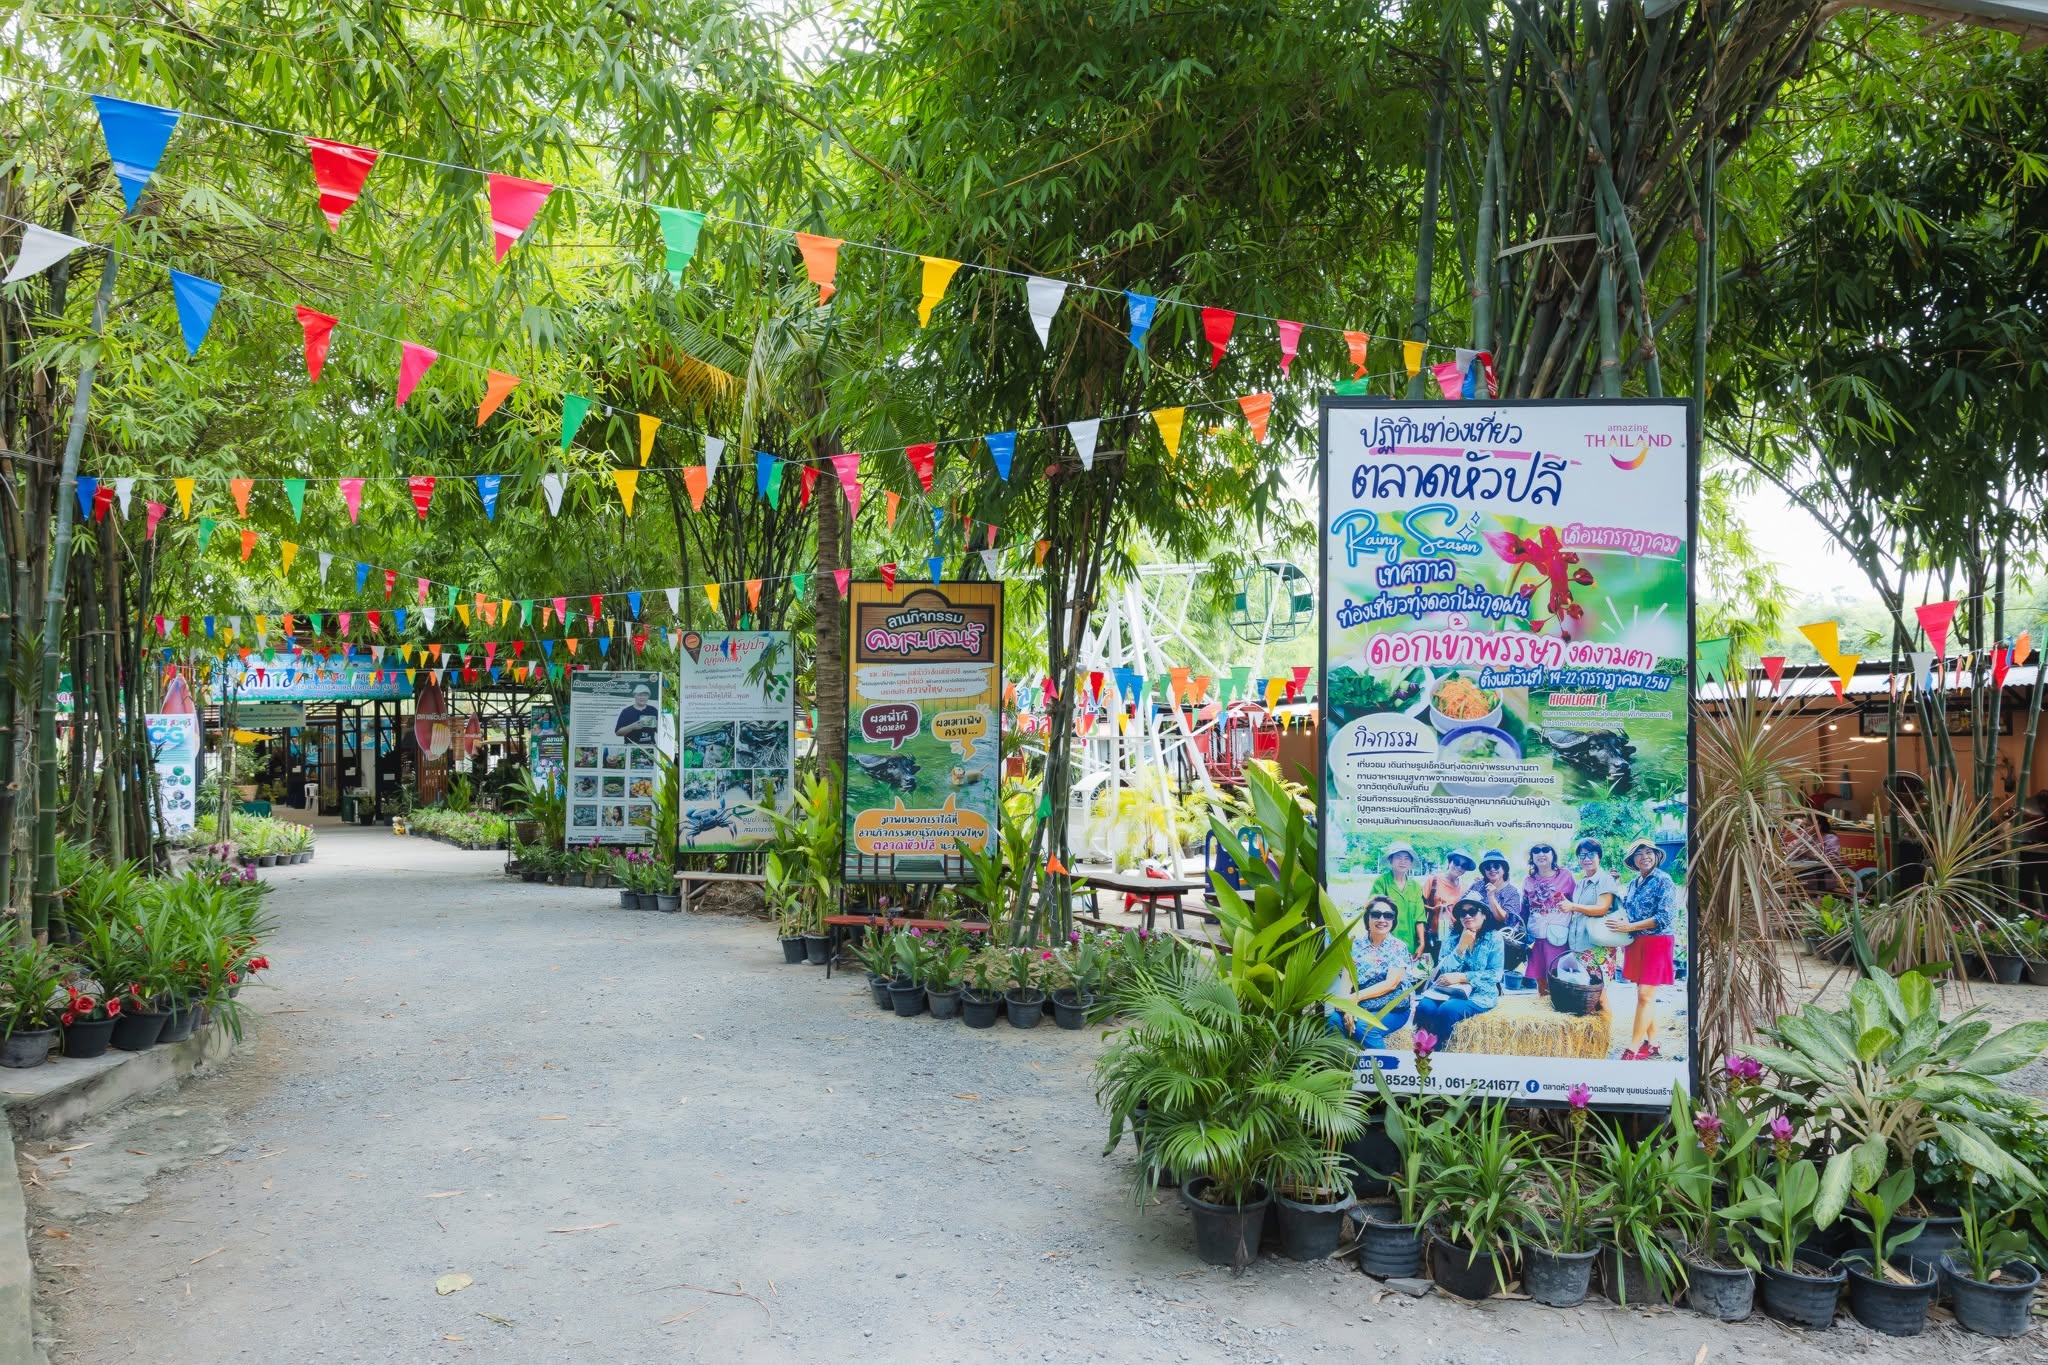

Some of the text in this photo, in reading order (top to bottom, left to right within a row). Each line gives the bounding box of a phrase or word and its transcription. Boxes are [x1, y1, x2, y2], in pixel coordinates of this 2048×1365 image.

[1360, 412, 1523, 454] ปฏิทินท่องเที่ยว
[1607, 424, 1649, 436] amazing
[1584, 434, 1673, 448] THAILAND
[1352, 451, 1568, 506] ตลาดหัวปลี
[1331, 503, 1483, 567] Rainy Season
[1561, 524, 1679, 555] เดือนกรกฎาคม
[1377, 561, 1455, 587] เทศกาล
[888, 610, 962, 628] ลานกิจกรรม
[1580, 671, 1642, 690] กรกฎาคม
[1645, 675, 1671, 690] 2567
[1549, 693, 1598, 706] HIGHLIGHT
[1354, 725, 1418, 748] กิจกรรม
[873, 839, 935, 850] ตลาดหัวปลี
